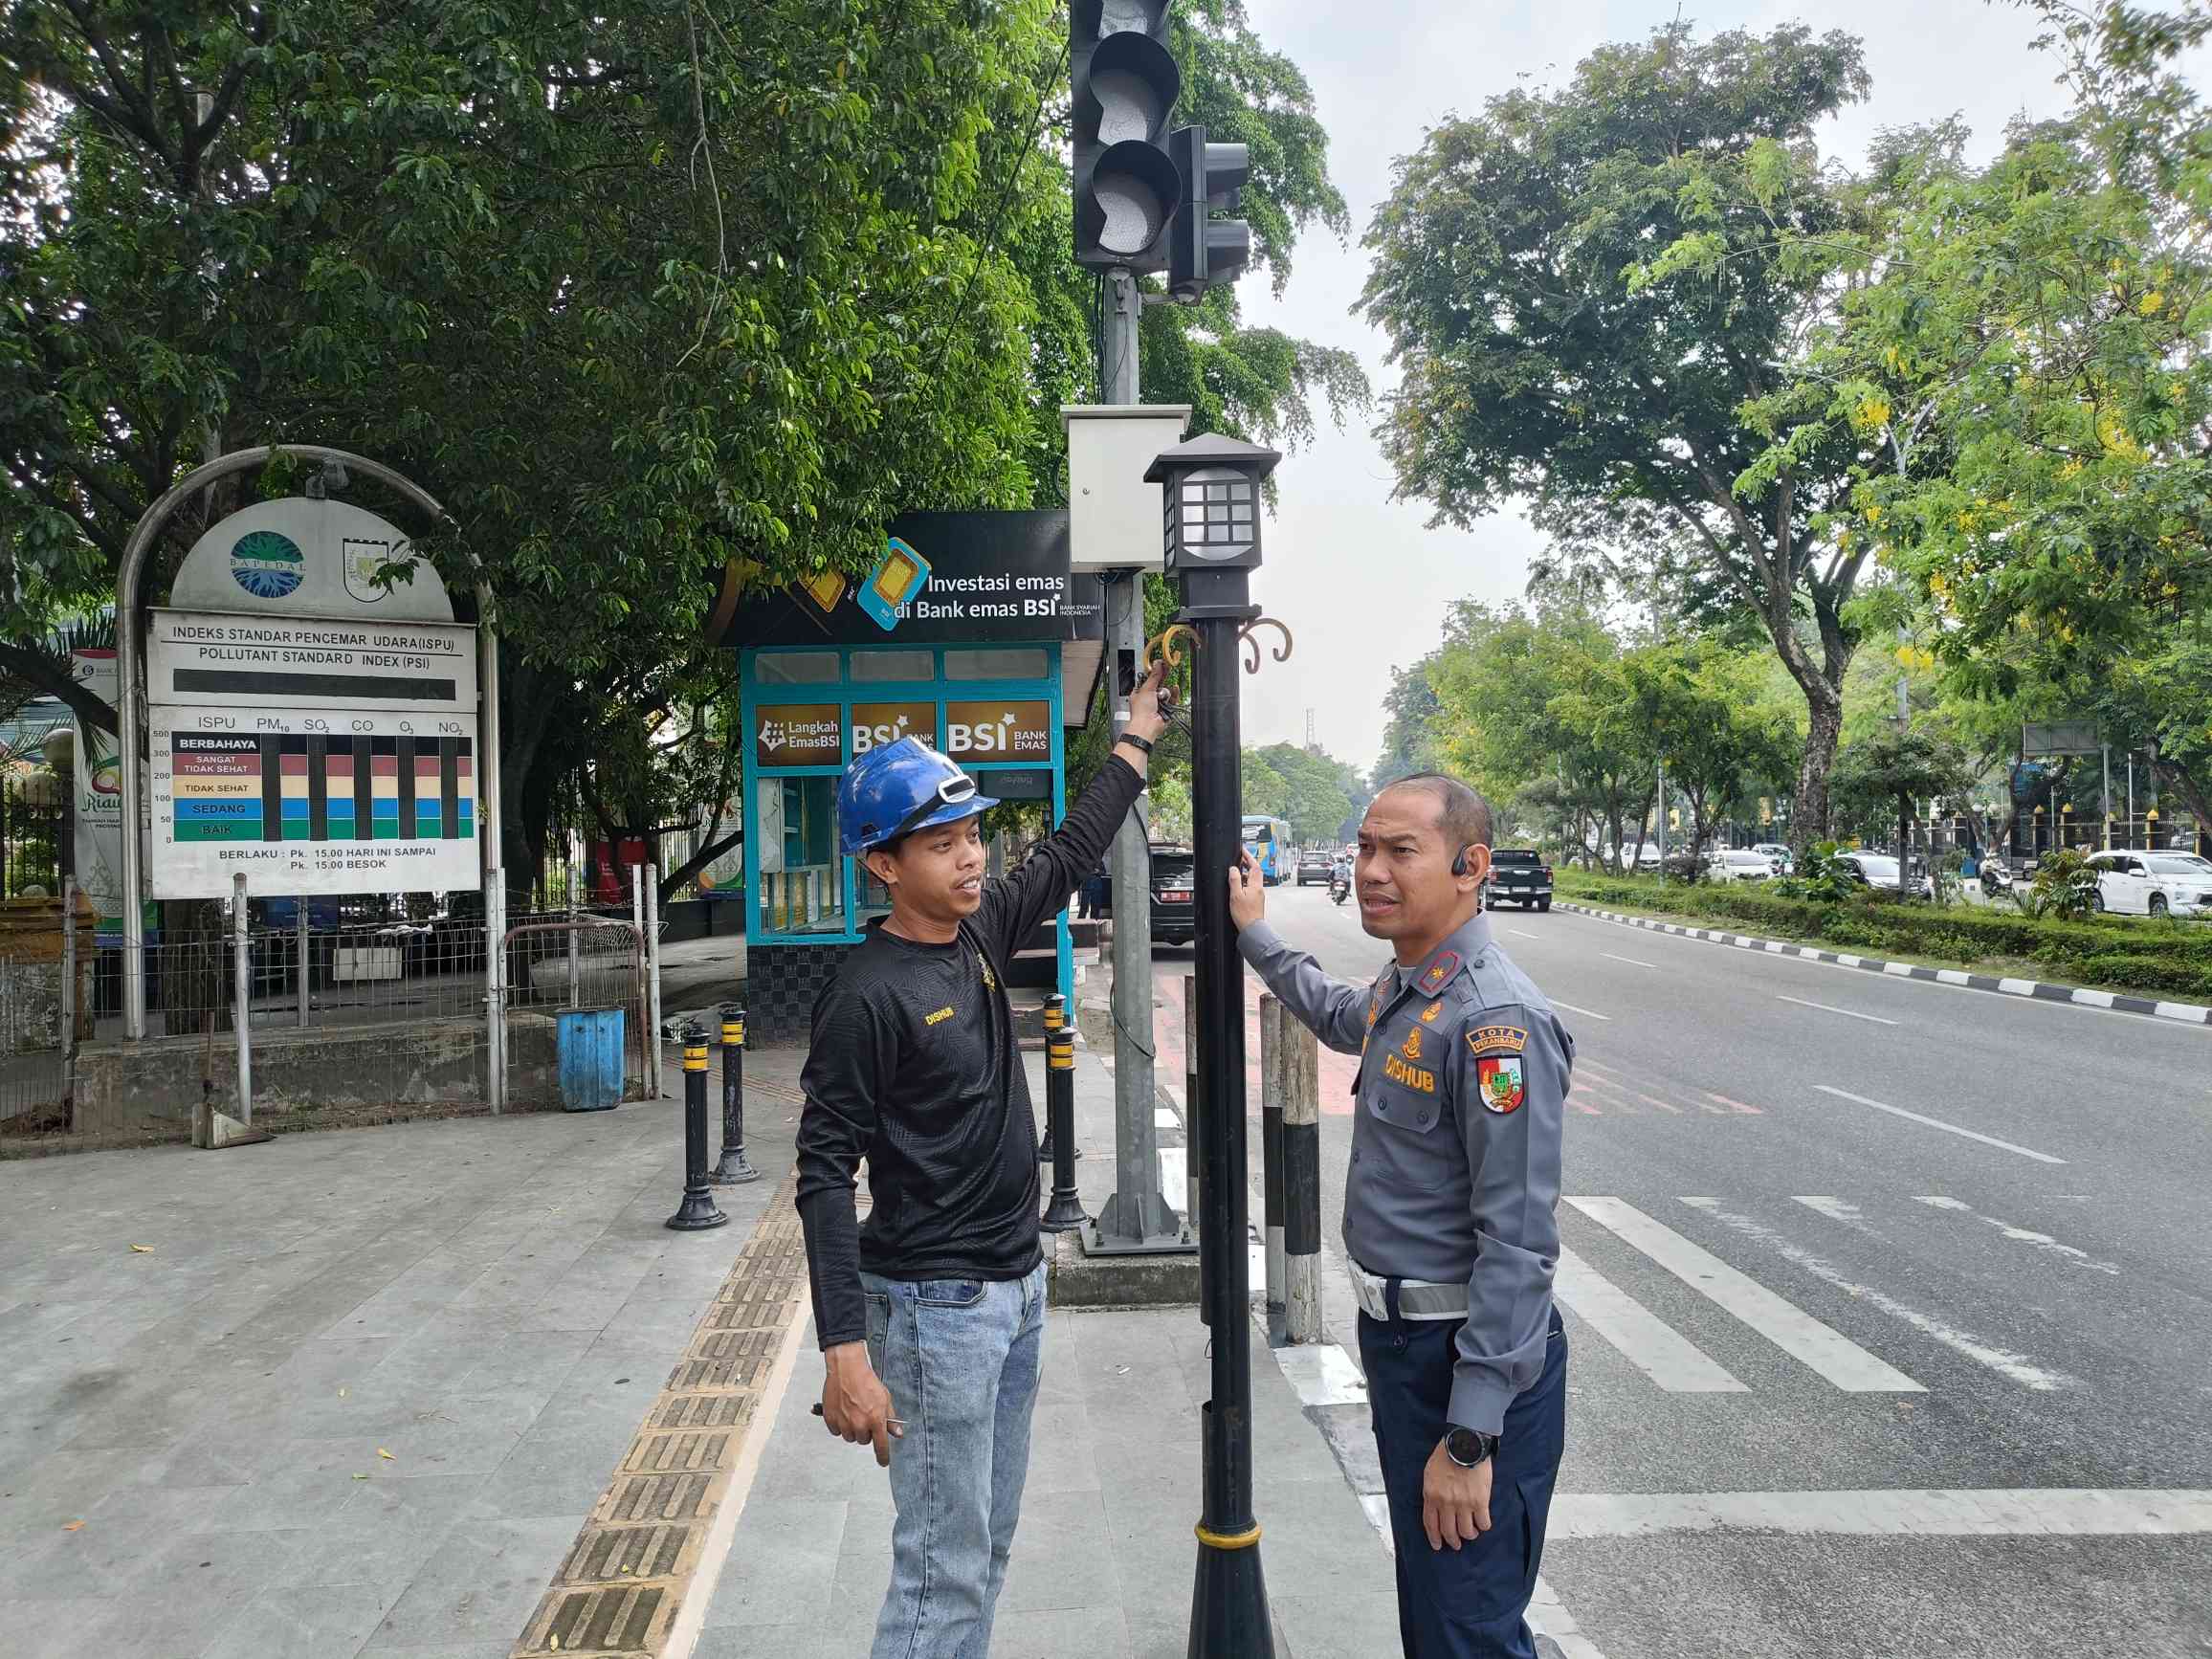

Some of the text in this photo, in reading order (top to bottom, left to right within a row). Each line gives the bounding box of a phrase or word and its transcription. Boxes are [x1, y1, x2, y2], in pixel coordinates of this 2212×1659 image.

[928, 573, 1064, 592] Investasi emas
[894, 601, 910, 619] di
[917, 600, 964, 619] Bank
[969, 603, 1018, 617] emas
[1024, 599, 1056, 616] BSI
[173, 626, 224, 639] INDEKS
[229, 629, 291, 642] STANDAR
[296, 632, 366, 645] PENCEMAR
[199, 647, 430, 669] POLLUTANT STANDARD INDEX (PSI)
[198, 717, 235, 728] ISPU
[351, 719, 373, 731] CO
[788, 720, 838, 734] Langkah
[180, 740, 256, 749] BERBAHAYA
[788, 736, 840, 748] EmasBSI
[852, 724, 900, 753] BSI
[947, 723, 1006, 752] BSI
[1014, 730, 1047, 741] BANK
[1014, 741, 1048, 750] EMAS
[192, 805, 246, 813] SEDANG
[202, 826, 231, 834] BAIK
[219, 850, 277, 859] BERLAKU
[290, 849, 307, 858] Pk.
[315, 849, 343, 858] 15.00
[346, 849, 373, 857] HARI
[377, 848, 391, 856] INI
[394, 847, 436, 856] SAMPAI
[290, 860, 387, 870] Pk. 15.00 BESOK
[925, 1006, 955, 1025] DISHUB
[1478, 1029, 1515, 1039] KOTA
[1385, 1054, 1435, 1093] DISHUB
